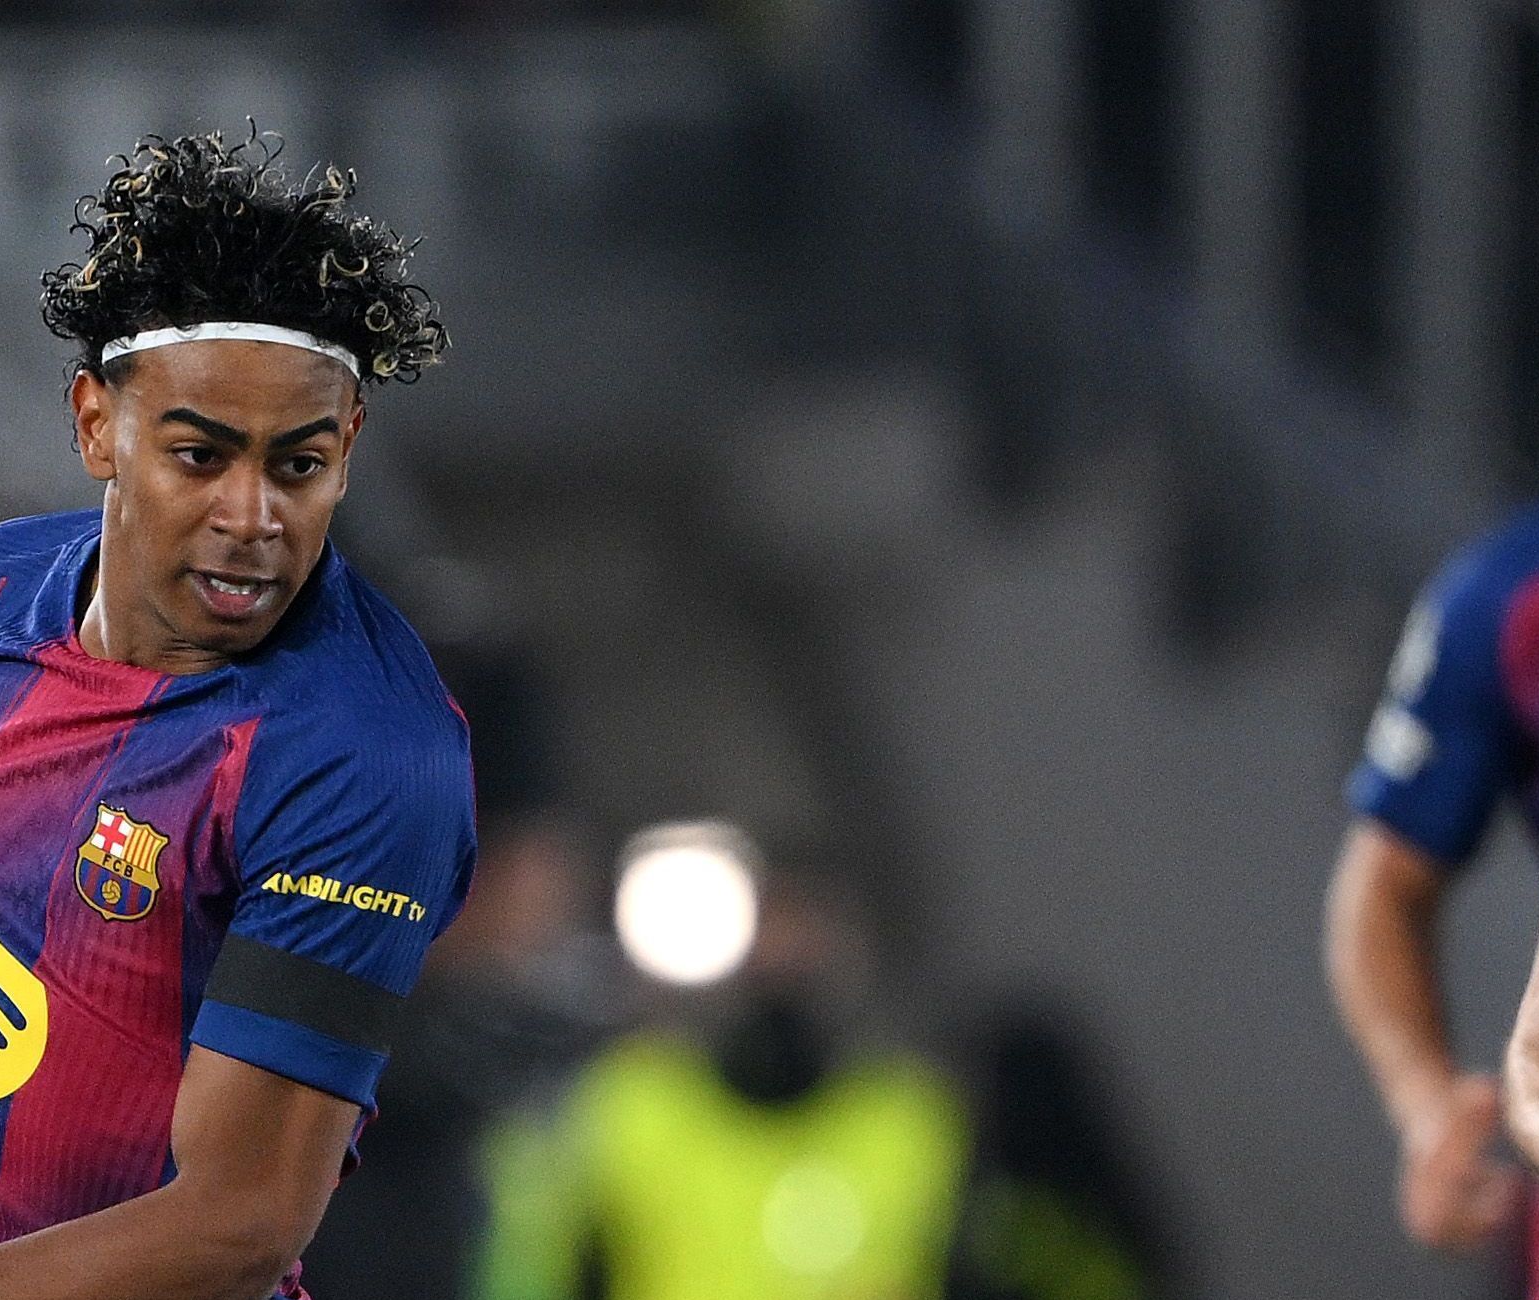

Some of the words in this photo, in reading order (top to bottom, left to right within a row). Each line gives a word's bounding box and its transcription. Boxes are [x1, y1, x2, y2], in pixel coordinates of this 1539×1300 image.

[101, 853, 134, 878] FCB
[261, 872, 410, 918] AMBILIGHT
[408, 901, 426, 922] tv
